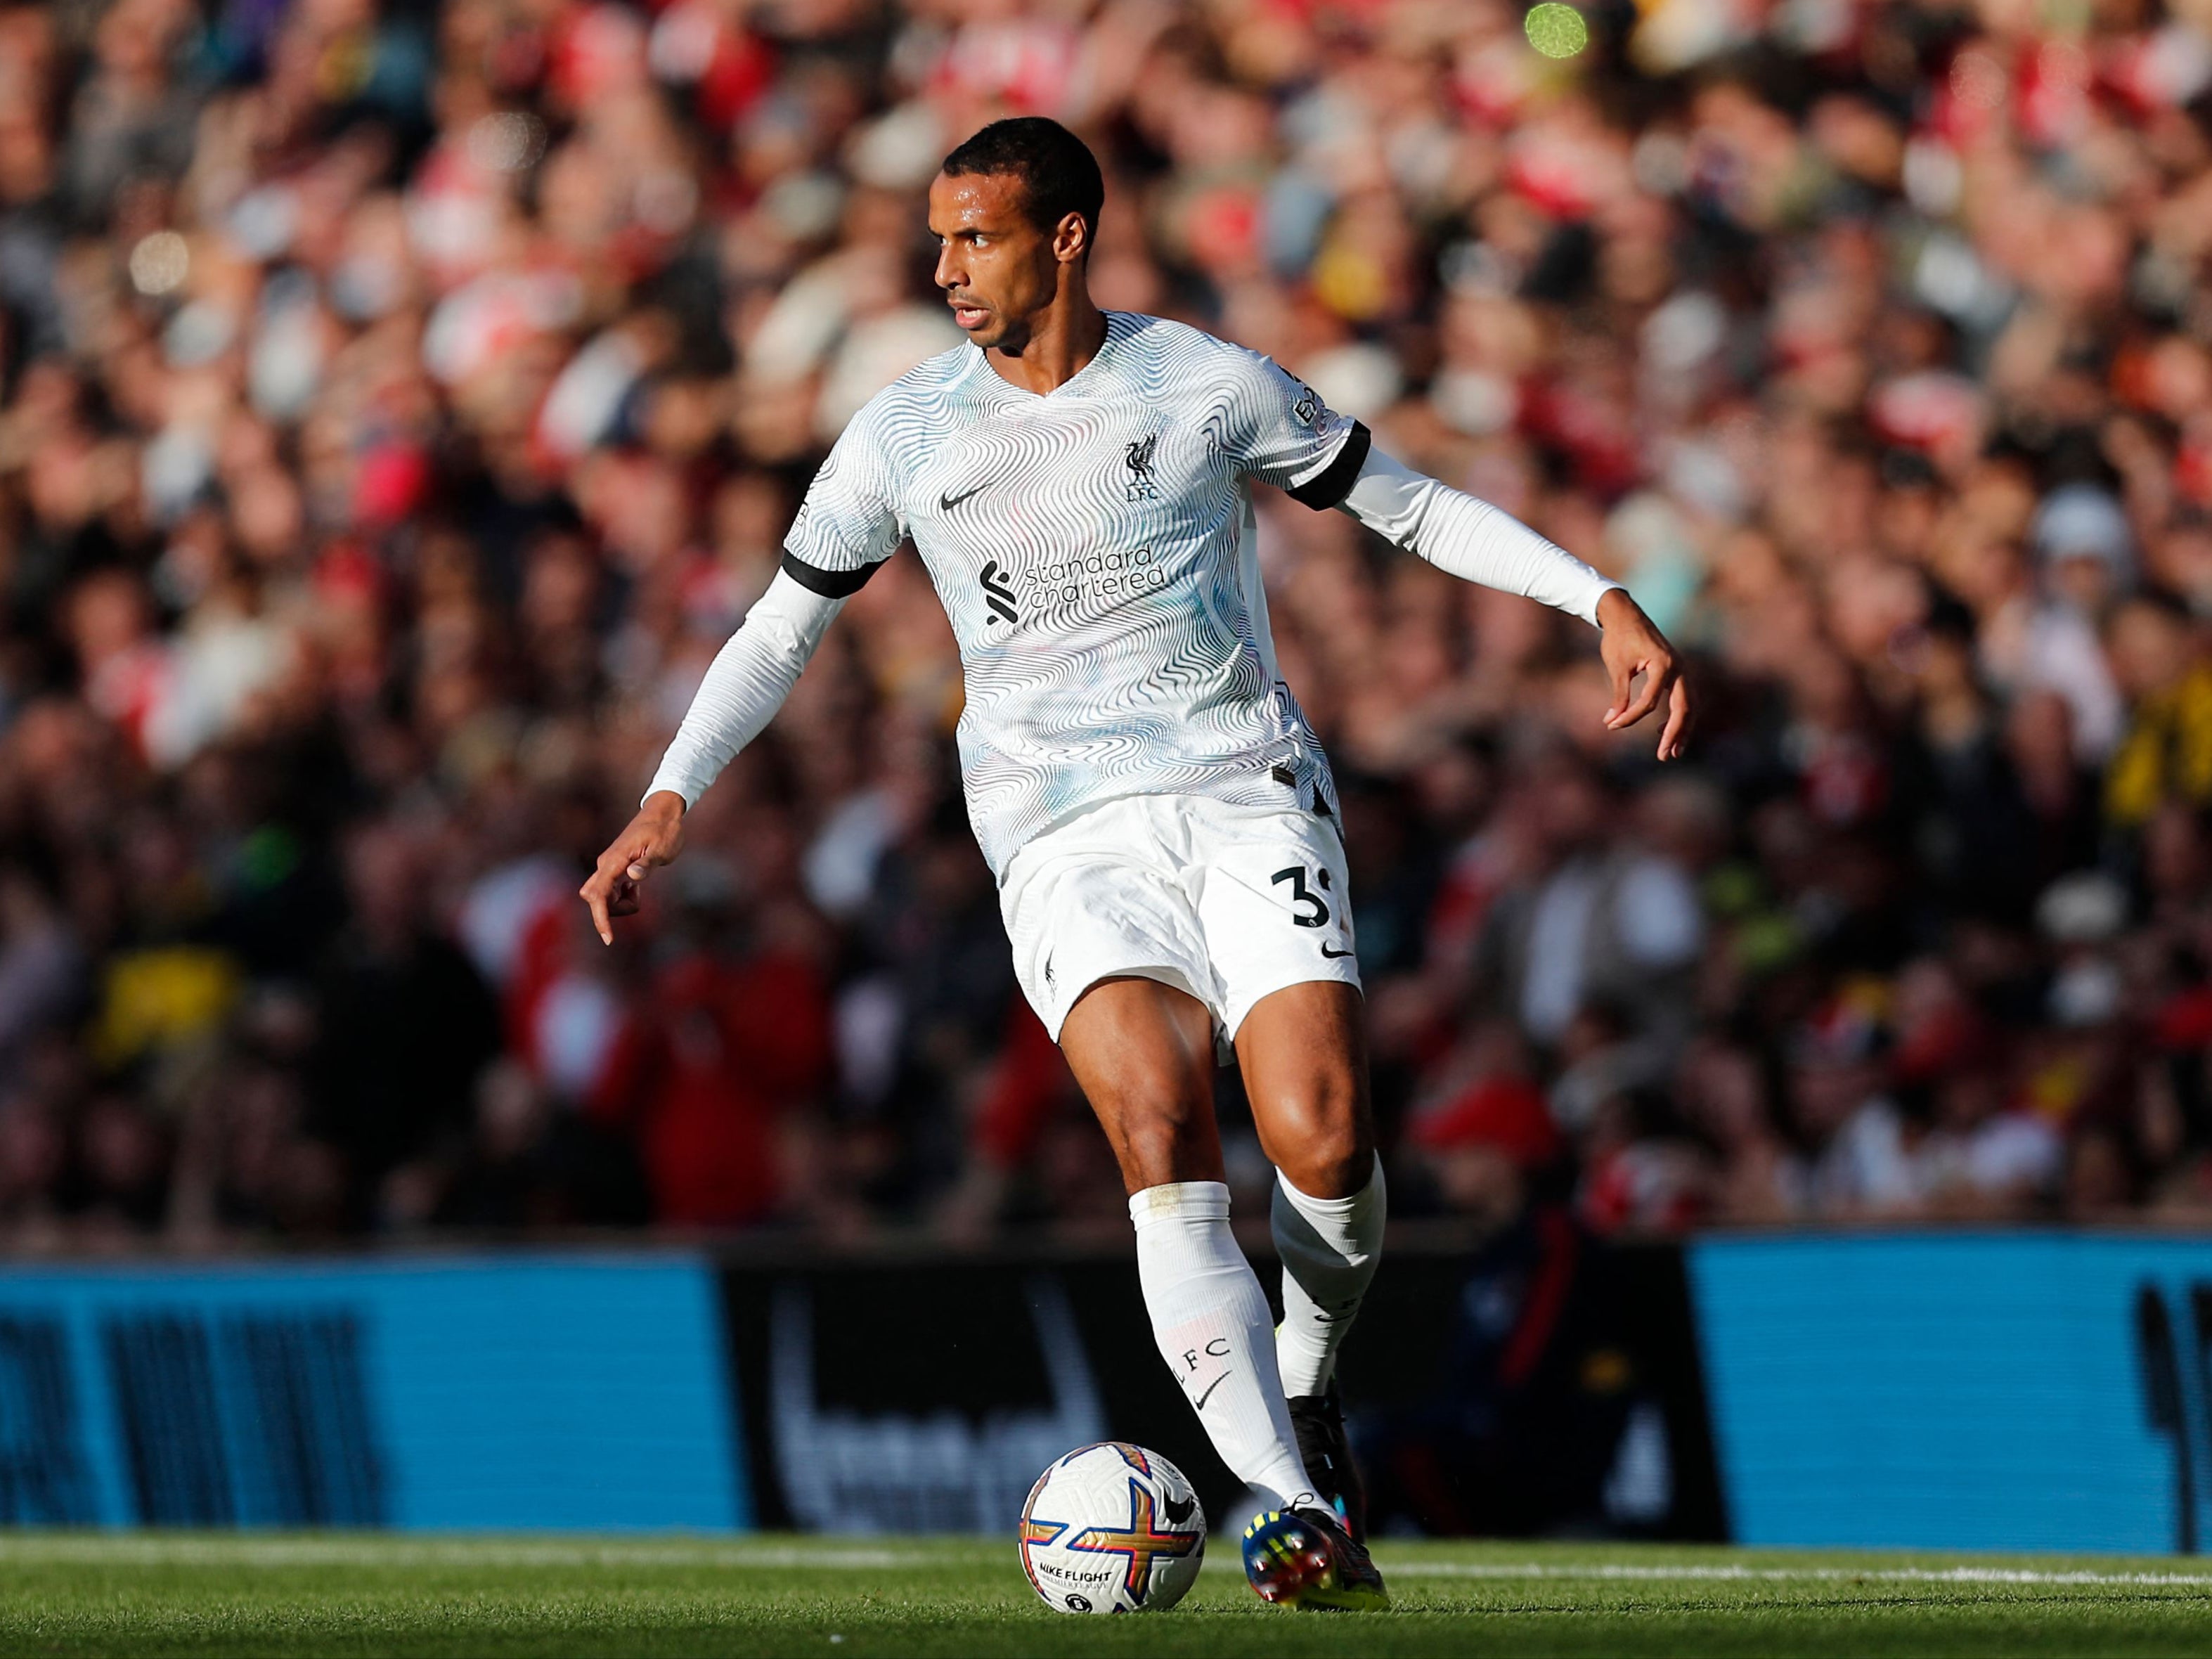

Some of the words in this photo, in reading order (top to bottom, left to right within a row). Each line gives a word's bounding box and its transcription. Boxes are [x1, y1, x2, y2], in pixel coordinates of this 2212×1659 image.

[1127, 486, 1158, 502] LFC
[1026, 544, 1151, 586] standard
[1030, 564, 1164, 608] chartered
[1040, 1562, 1062, 1577] NIKE
[1065, 1571, 1112, 1582] FLIGHT
